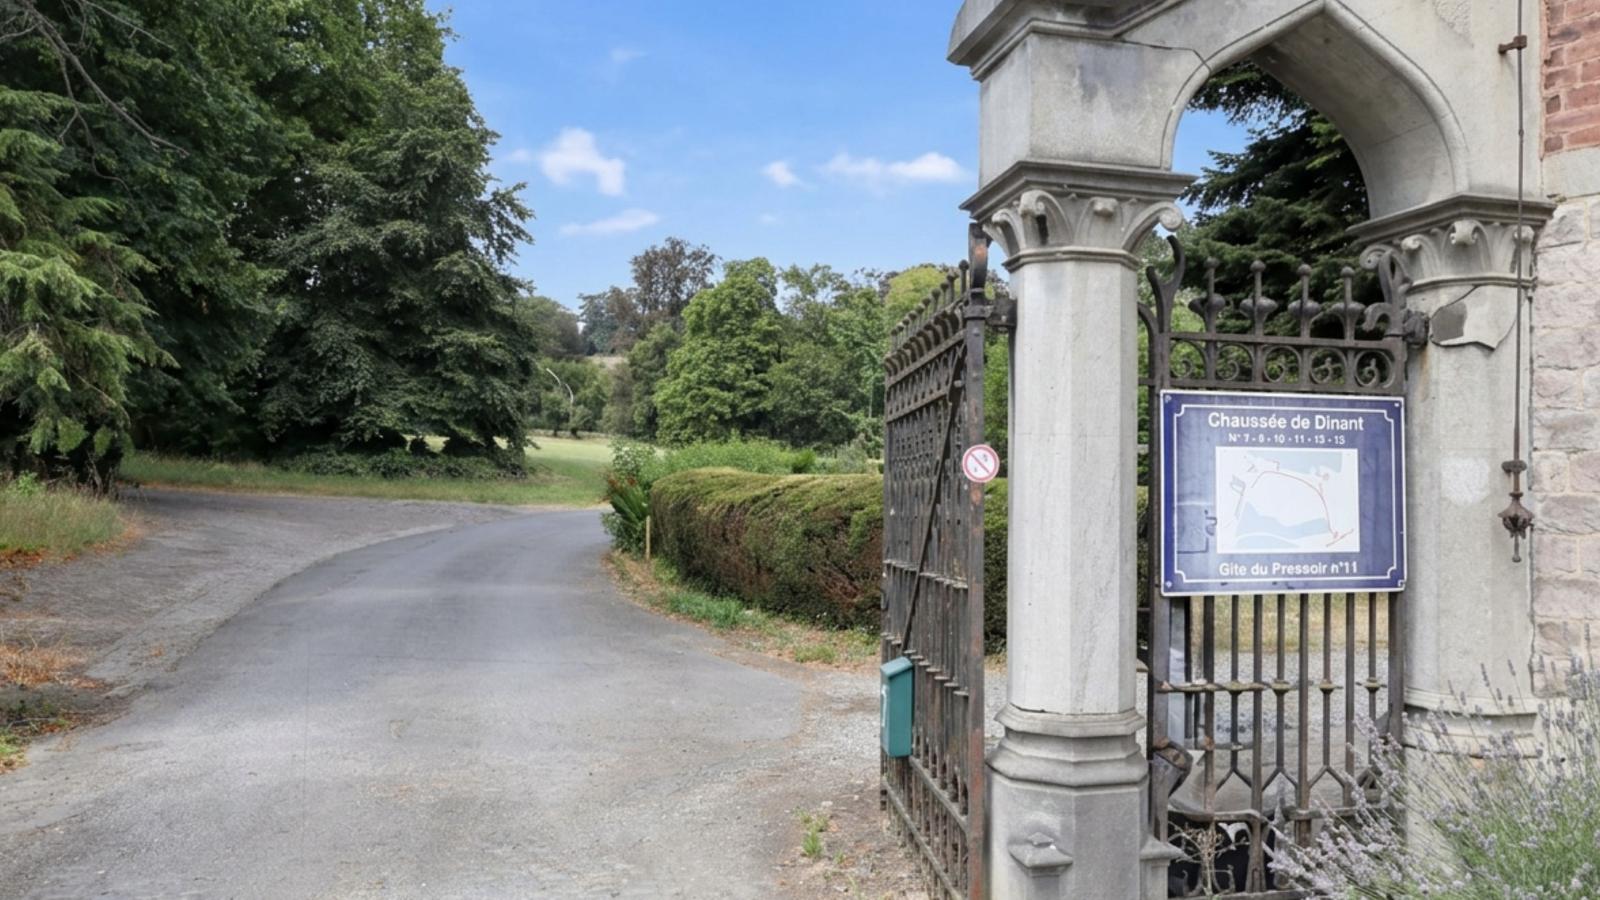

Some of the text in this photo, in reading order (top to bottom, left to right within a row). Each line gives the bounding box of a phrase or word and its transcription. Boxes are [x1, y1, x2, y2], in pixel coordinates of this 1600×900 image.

[1208, 412, 1364, 431] Chaussée de Dinant
[1295, 434, 1305, 444] 11
[1251, 562, 1268, 576] du
[1272, 561, 1327, 575] Pressoir
